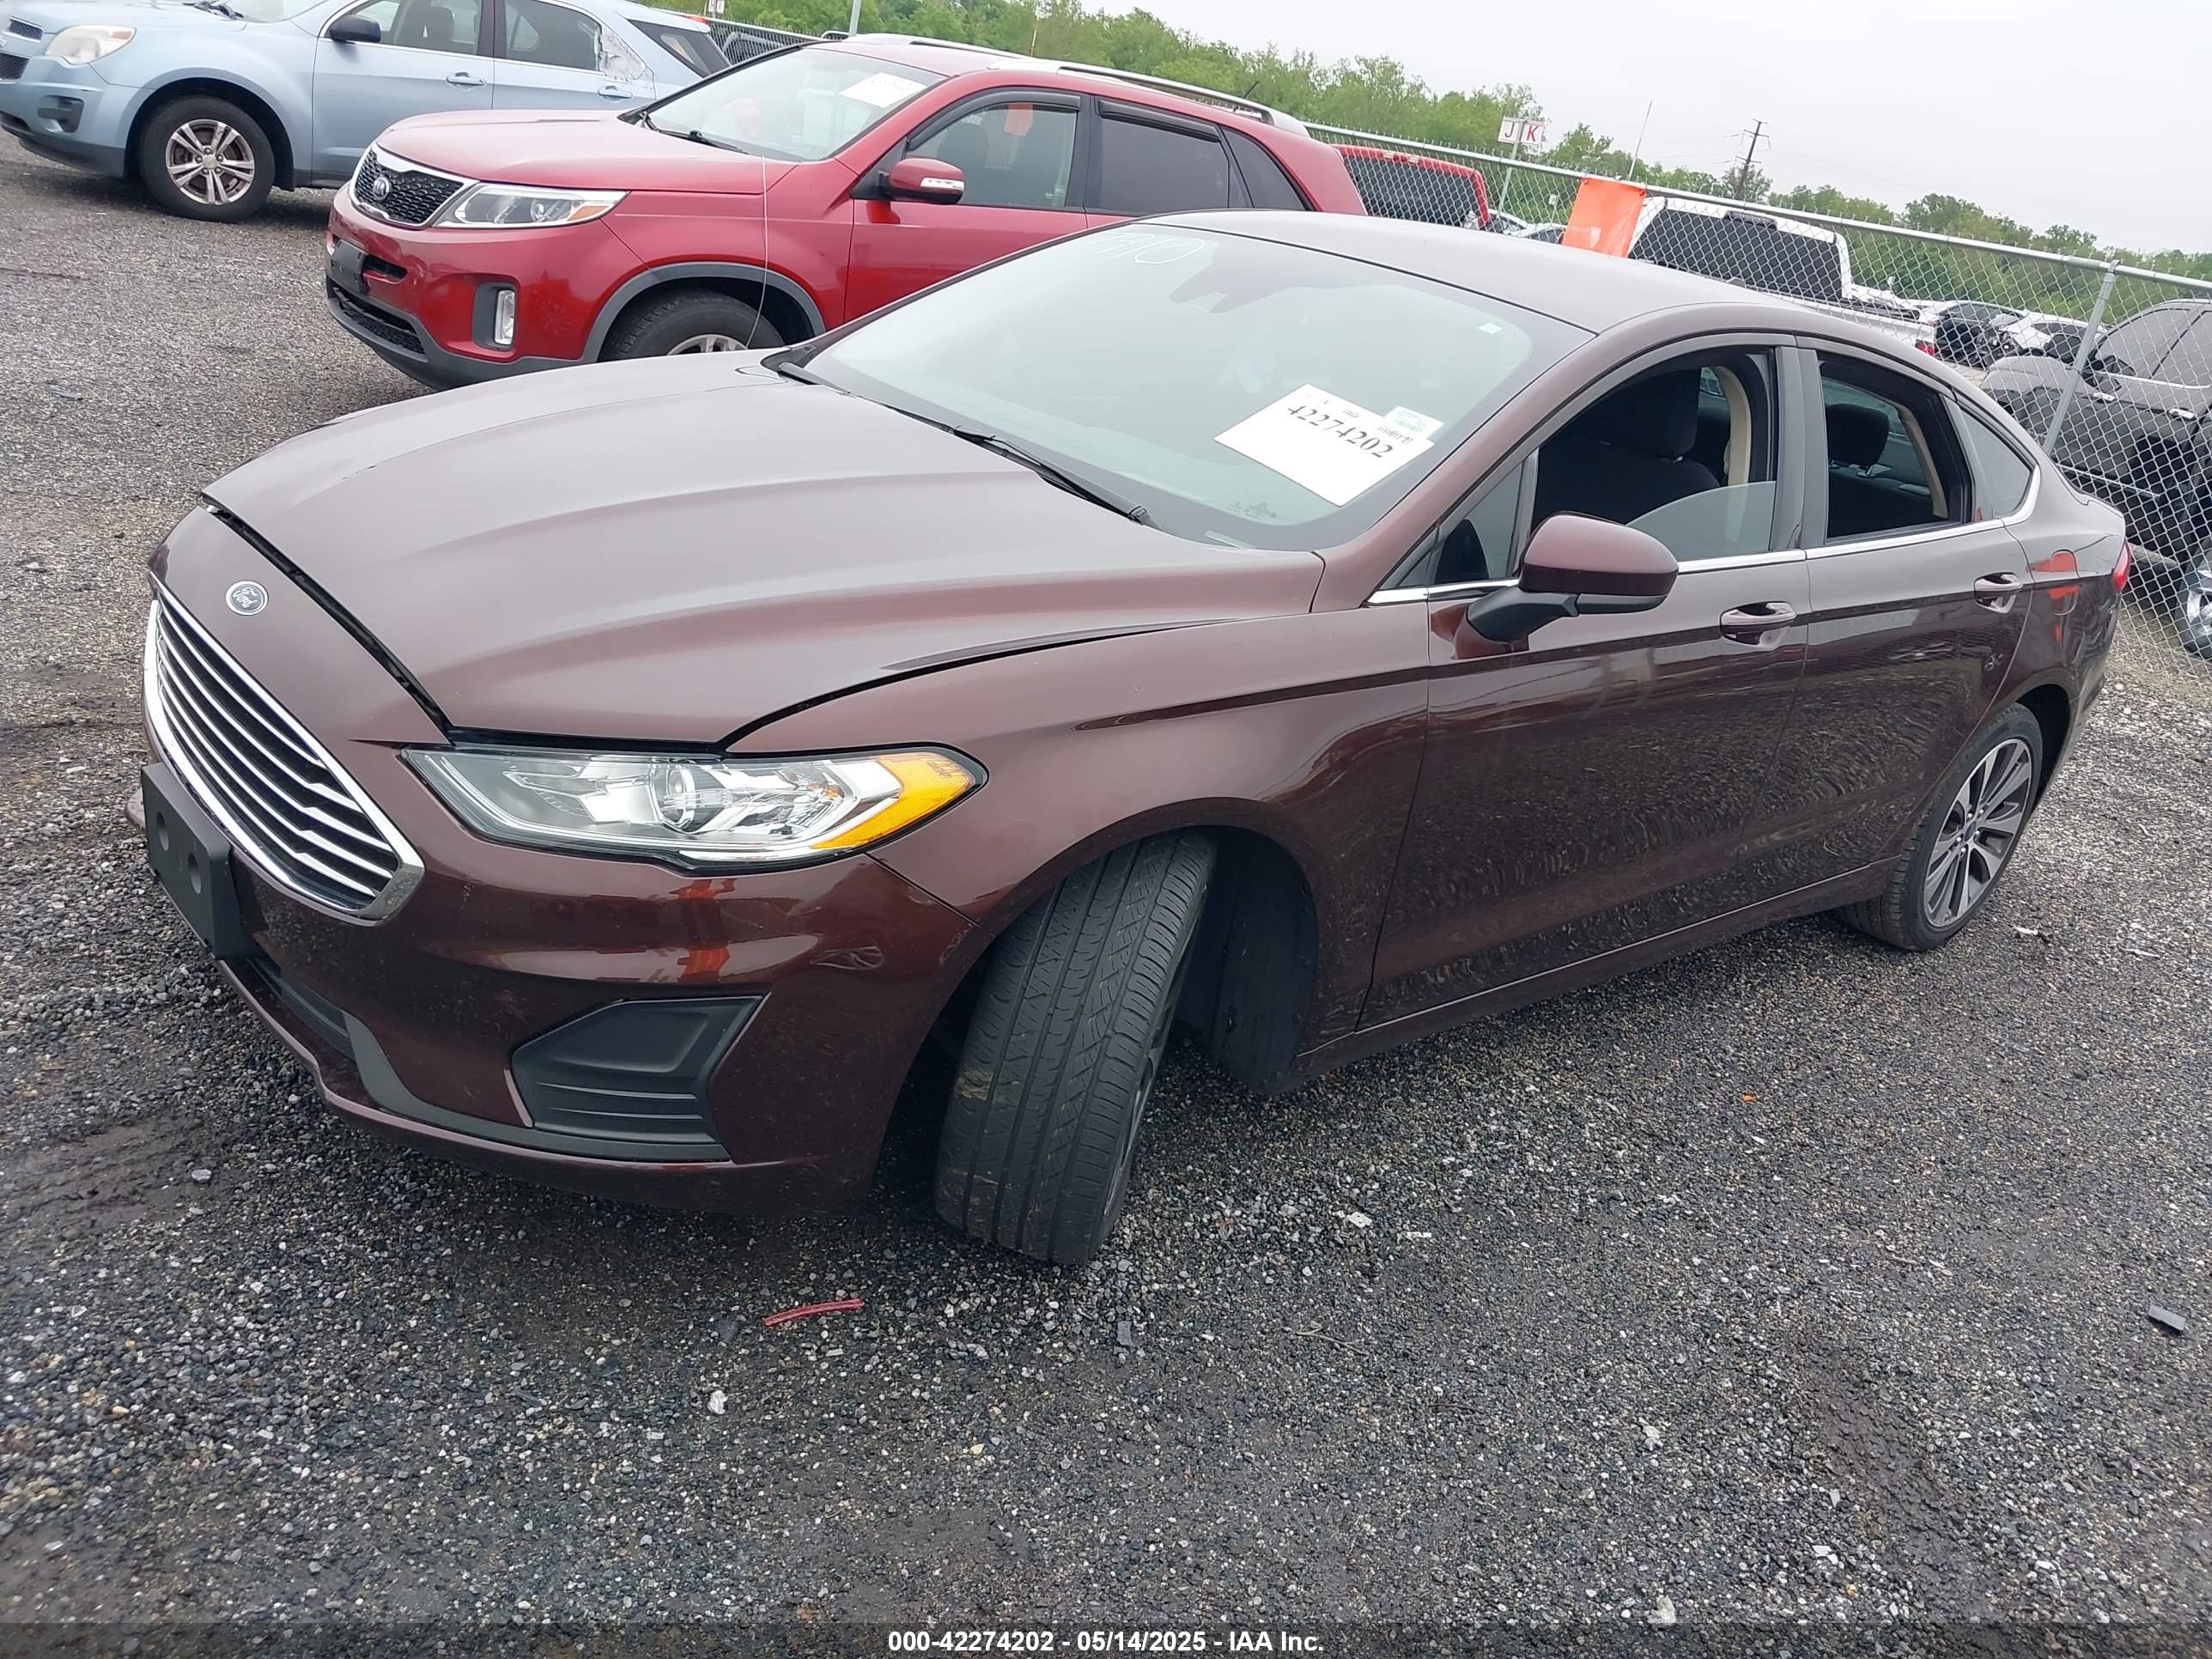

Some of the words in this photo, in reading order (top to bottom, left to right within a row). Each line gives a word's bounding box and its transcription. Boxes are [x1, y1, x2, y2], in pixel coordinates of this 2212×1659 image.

[1504, 122, 1516, 138] J
[1526, 125, 1540, 143] K
[1286, 404, 1394, 459] 42274202
